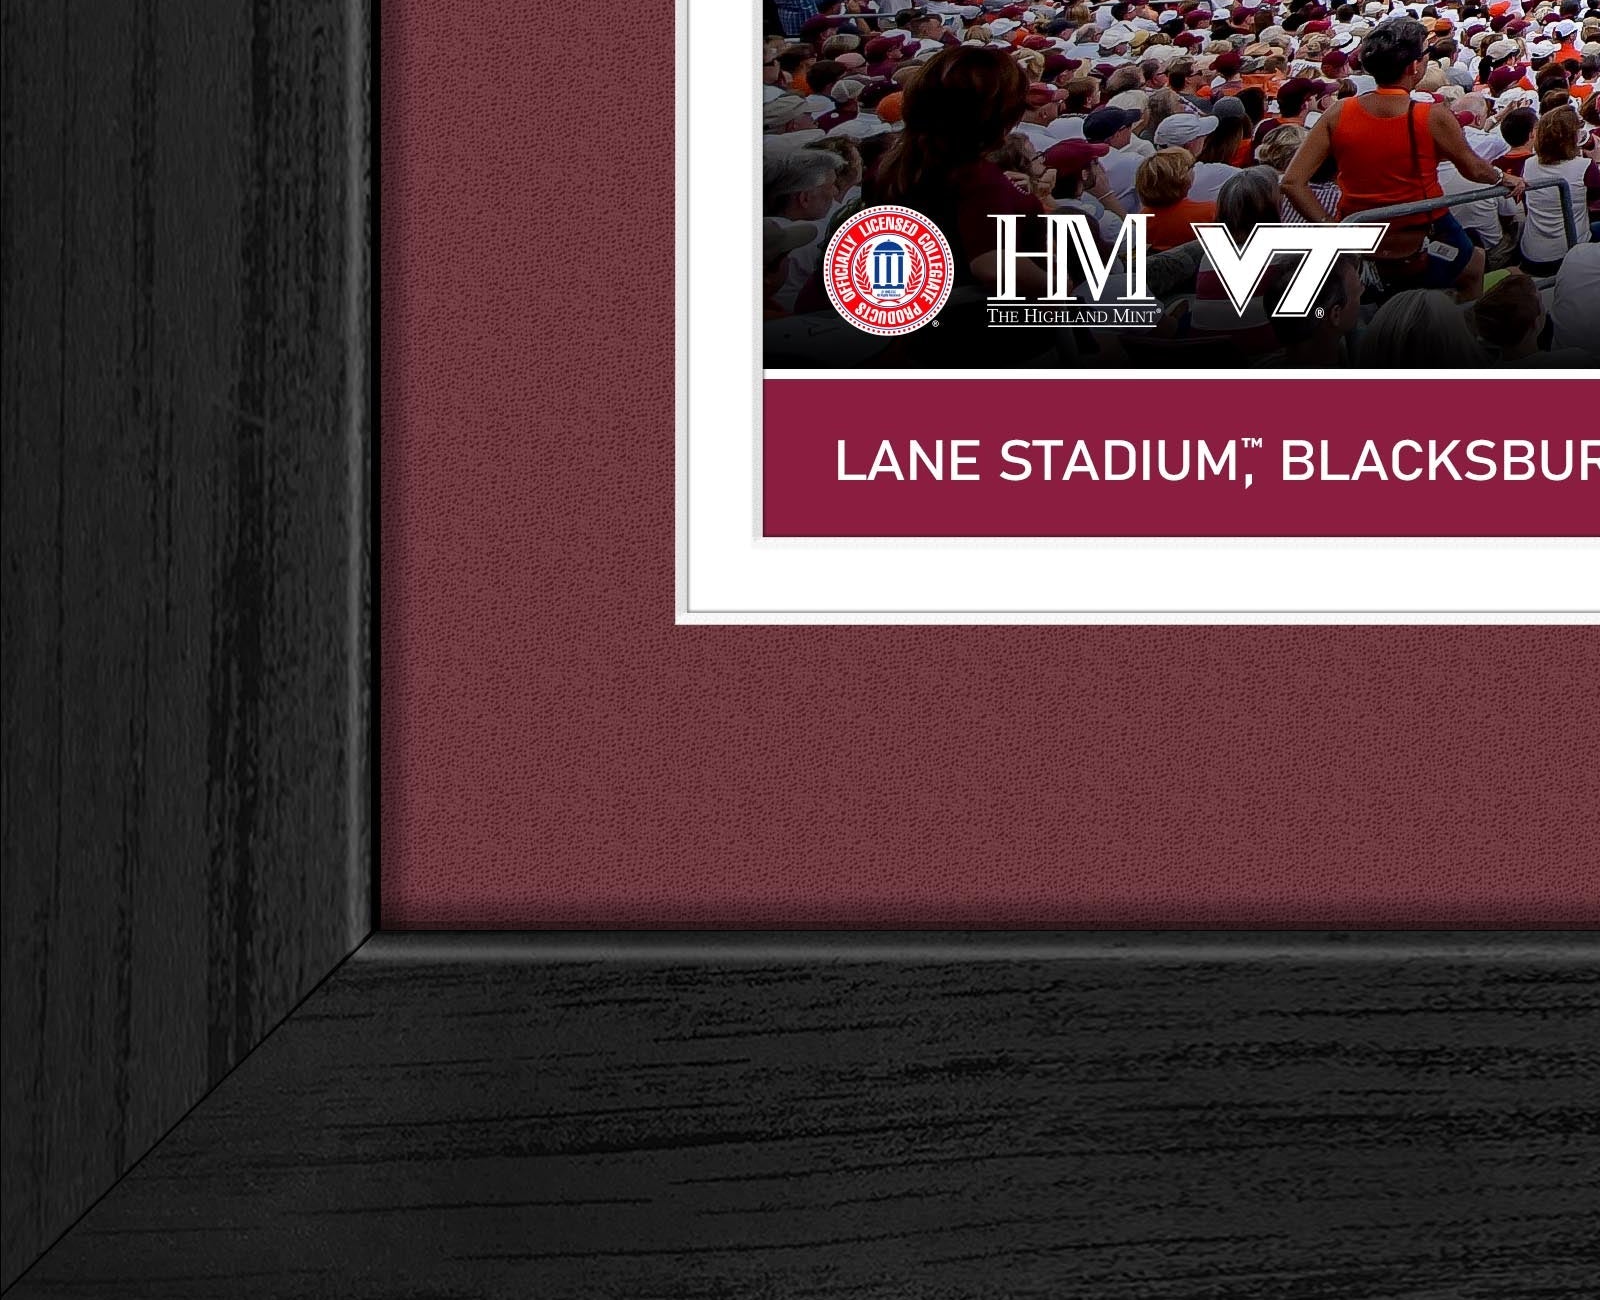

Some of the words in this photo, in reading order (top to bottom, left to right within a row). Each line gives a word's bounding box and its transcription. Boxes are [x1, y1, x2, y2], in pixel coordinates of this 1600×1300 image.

[858, 216, 919, 238] LICENSED
[834, 233, 859, 303] OFFICIALLY
[917, 233, 943, 305] COLLEGIATE
[987, 213, 1156, 302] HM
[1189, 222, 1392, 319] VT
[854, 301, 923, 325] PRODUCTS
[1023, 308, 1108, 323] HIGHLAND
[837, 439, 980, 481] LANE
